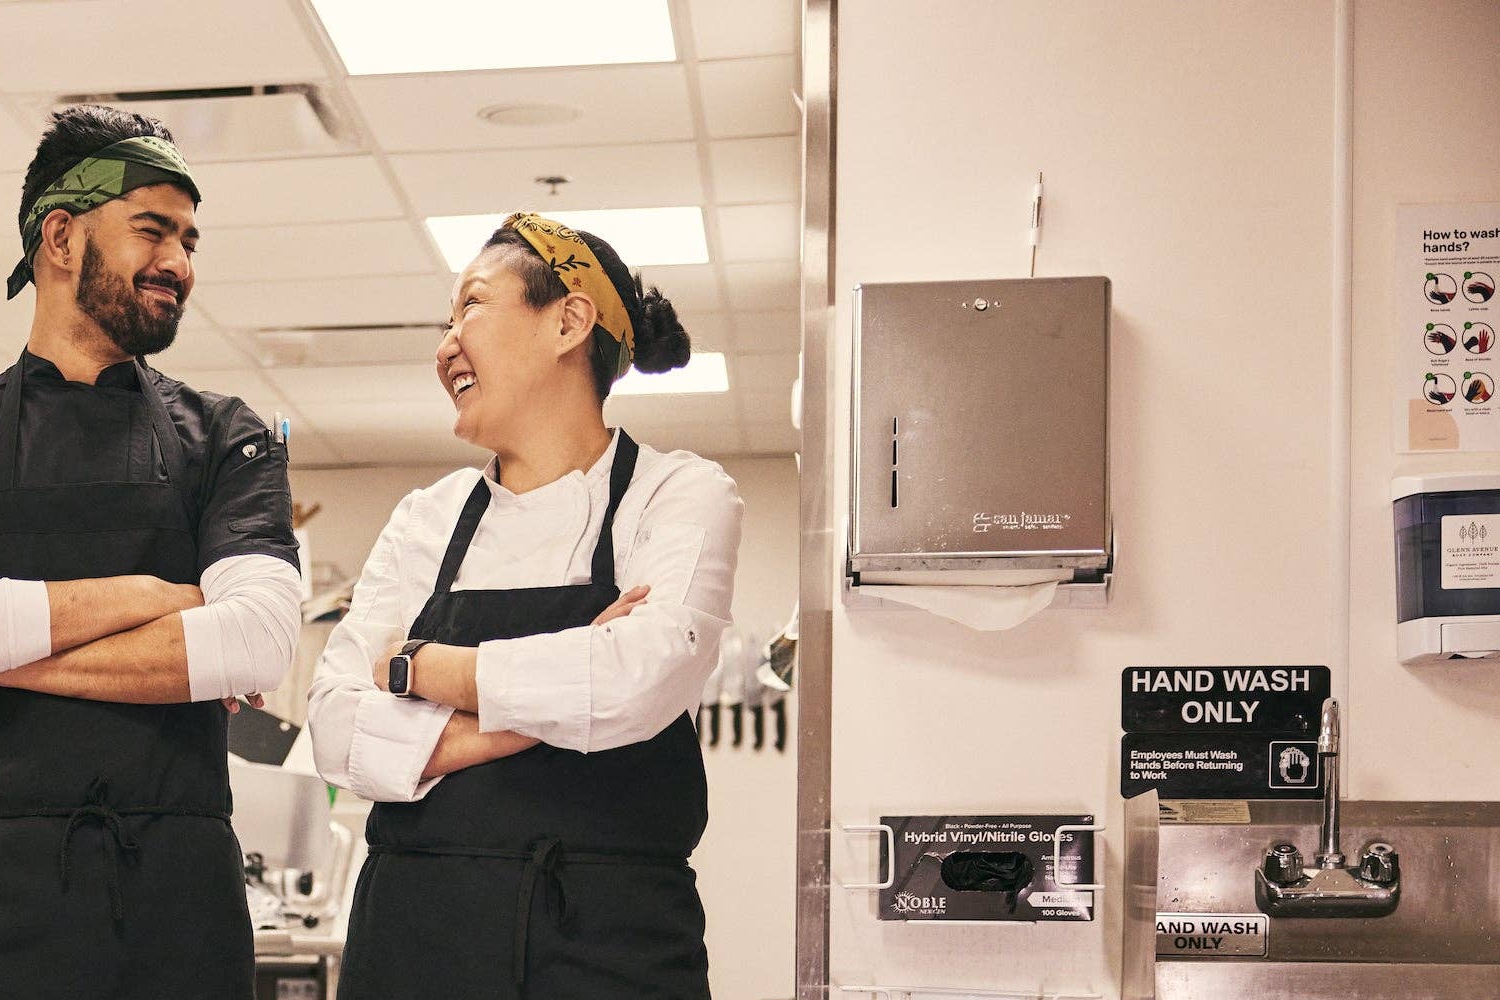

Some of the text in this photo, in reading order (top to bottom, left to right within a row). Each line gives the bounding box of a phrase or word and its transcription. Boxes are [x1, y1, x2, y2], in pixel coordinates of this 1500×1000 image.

[1423, 228, 1500, 240] How to wash
[1423, 241, 1470, 253] hands?
[1132, 670, 1310, 692] HAND WASH
[1181, 701, 1260, 723] ONLY
[1130, 751, 1237, 761] Employees Must Wash
[1130, 761, 1243, 772] Hands Before Returning
[1130, 771, 1167, 779] to Work
[904, 832, 947, 844] Hybrid
[950, 832, 1026, 844] Vinyl/Nitrile
[897, 896, 947, 909] NOBLE
[1202, 922, 1258, 935] WASH
[1174, 936, 1223, 949] ONLY
